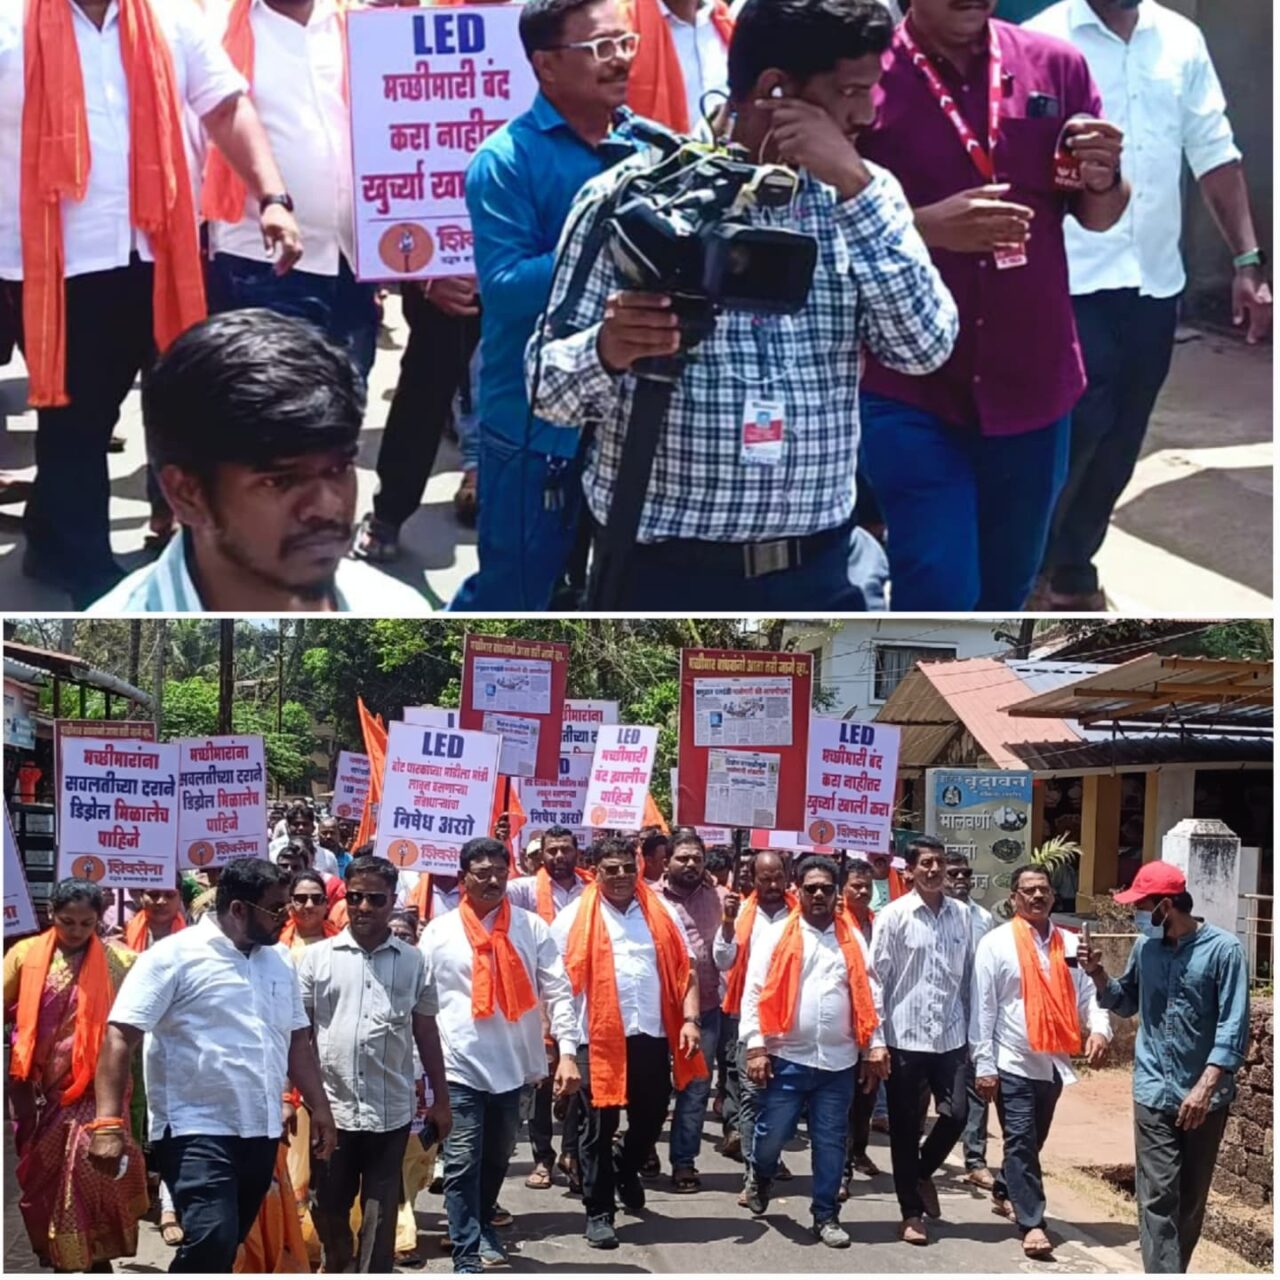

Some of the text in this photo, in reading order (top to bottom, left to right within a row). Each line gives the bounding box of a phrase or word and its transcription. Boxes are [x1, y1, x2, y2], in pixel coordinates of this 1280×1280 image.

[412, 13, 486, 55] LED
[383, 58, 511, 102] मच्छीमारी बंद
[389, 121, 430, 152] करा
[431, 170, 466, 202] खा
[421, 731, 465, 758] LED
[617, 728, 640, 744] LED
[839, 722, 875, 746] LED
[83, 743, 160, 770] मच्छीमारांना
[190, 739, 249, 762] मच्छीमारांना
[65, 771, 176, 797] सवलतीच्या दराने
[179, 762, 263, 787] सवलतीच्या दराने
[70, 796, 170, 824] डिझेल मिळालेच
[183, 789, 215, 811] डिझेल
[837, 795, 868, 815] खाली
[206, 810, 239, 833] पाहिजे
[394, 806, 476, 836] निषेध असो
[530, 808, 558, 825] निषेध
[97, 825, 140, 850] पाहिजे
